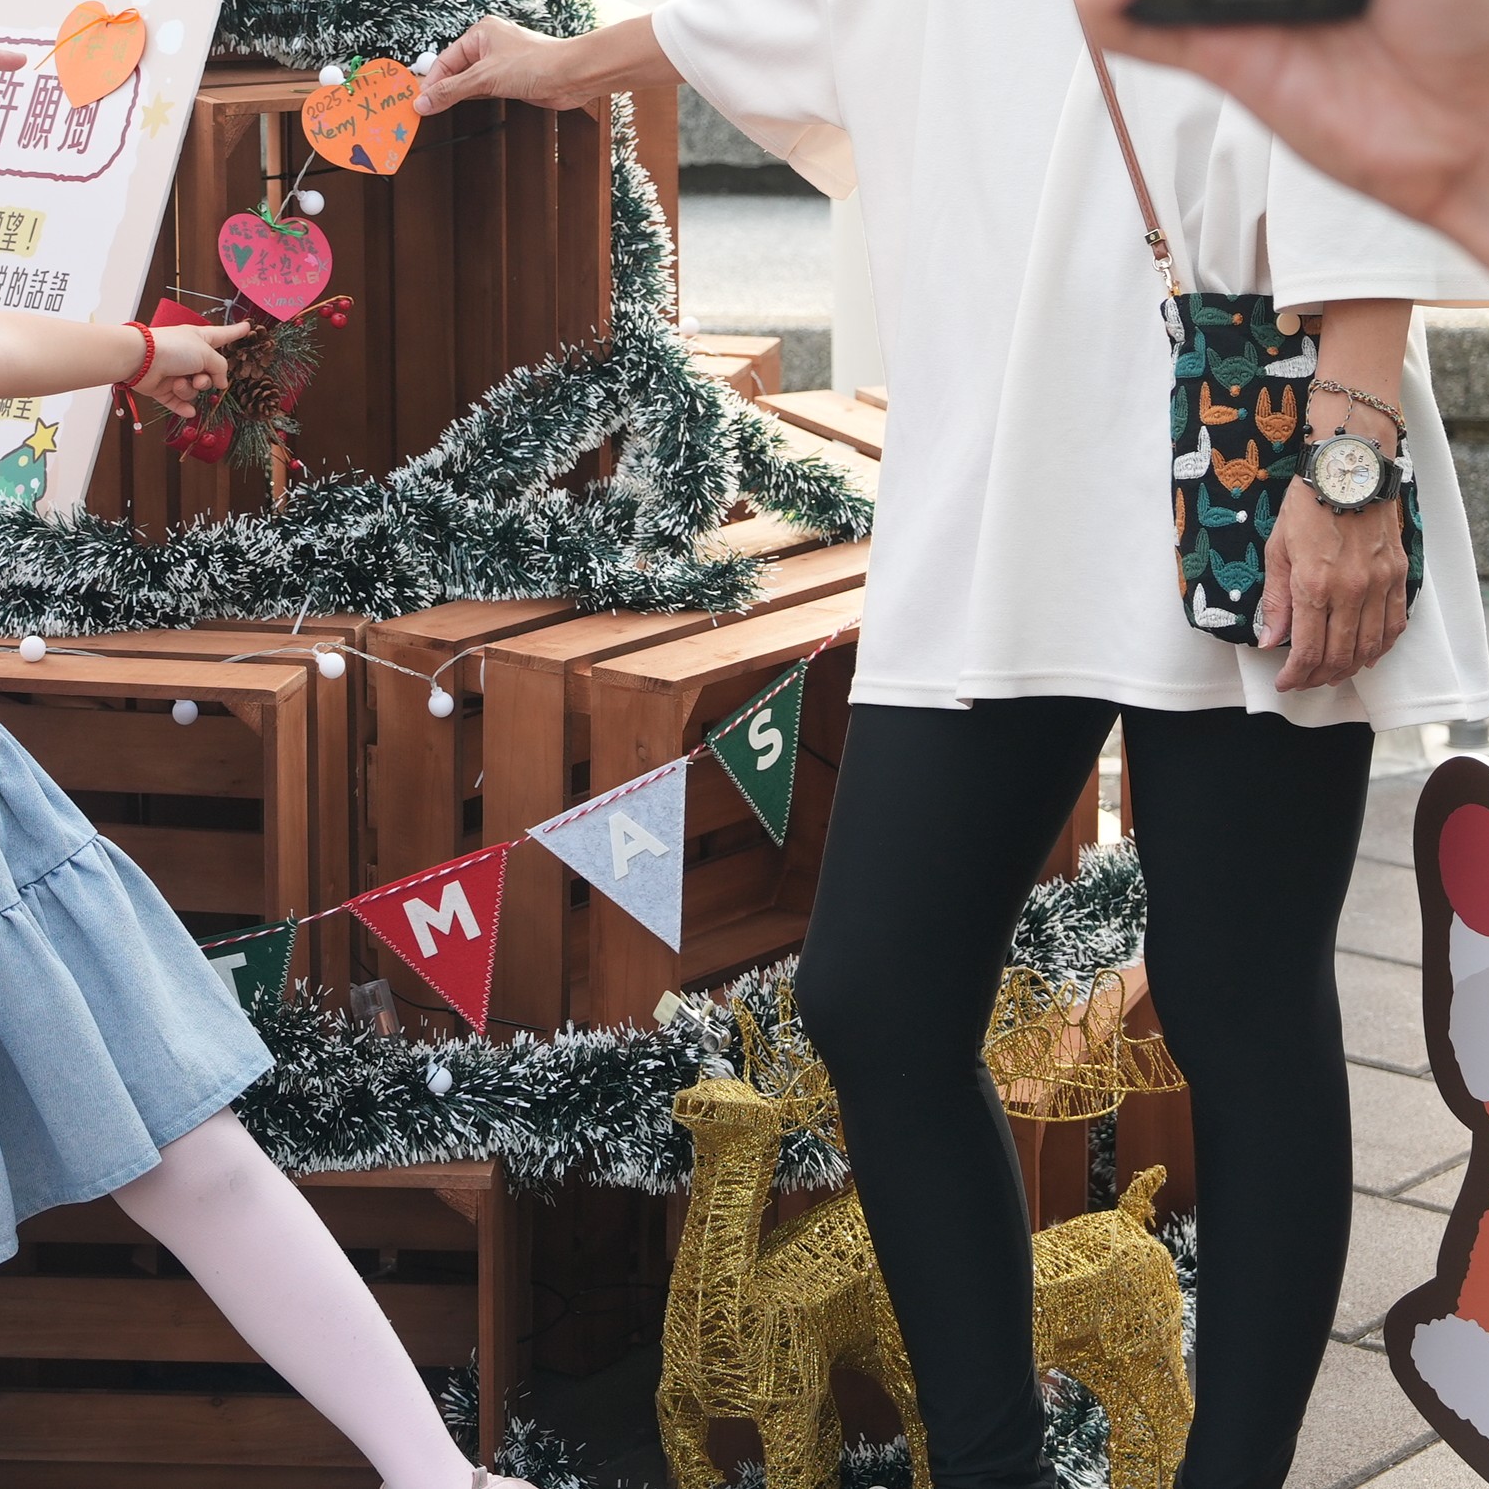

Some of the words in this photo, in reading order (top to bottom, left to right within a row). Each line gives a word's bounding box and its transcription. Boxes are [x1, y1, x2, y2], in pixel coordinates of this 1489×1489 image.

[310, 116, 357, 144] Merry
[357, 84, 415, 121] X'mas
[402, 879, 481, 958] M
[608, 811, 670, 880] A
[747, 708, 784, 771] S
